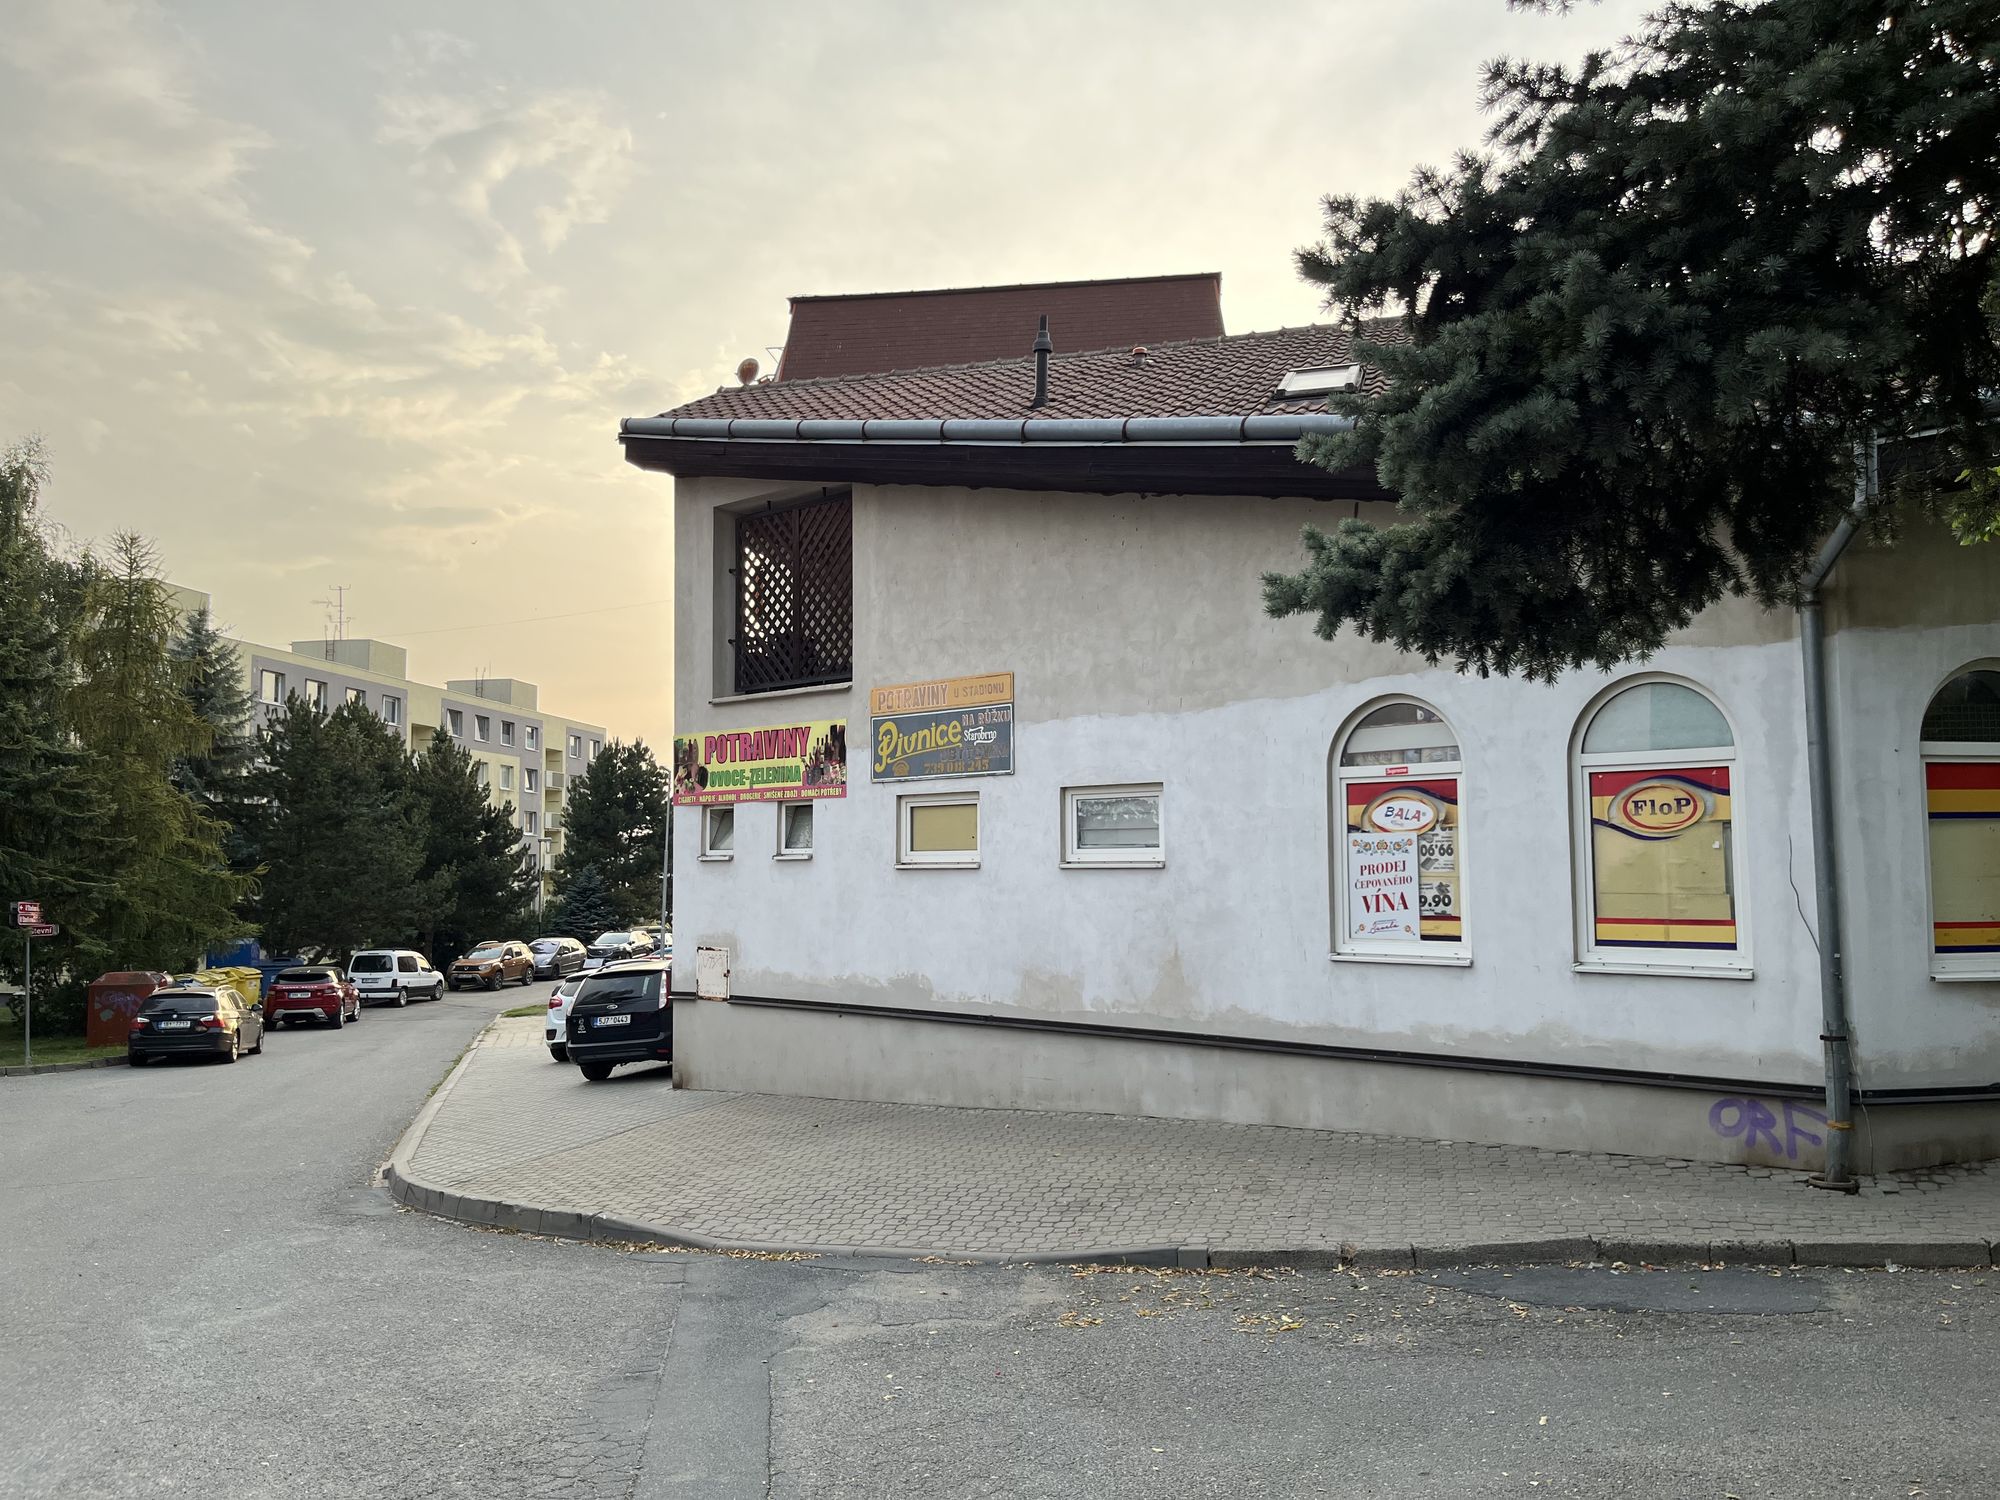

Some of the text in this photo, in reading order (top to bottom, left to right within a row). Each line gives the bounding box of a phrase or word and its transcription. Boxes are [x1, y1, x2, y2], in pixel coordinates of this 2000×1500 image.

[878, 682, 1005, 711] POTRAVINY U STADIONU
[962, 713, 975, 726] NA
[964, 727, 997, 742] Starobrno
[704, 727, 811, 765] POTRAVINY
[1384, 806, 1421, 822] BALA
[1632, 797, 1692, 816] FloP
[1360, 860, 1406, 876] PRODEJ
[1354, 875, 1413, 890] ČEPOVANÉHO
[1362, 888, 1409, 914] VÍNA
[613, 1015, 629, 1024] 0443
